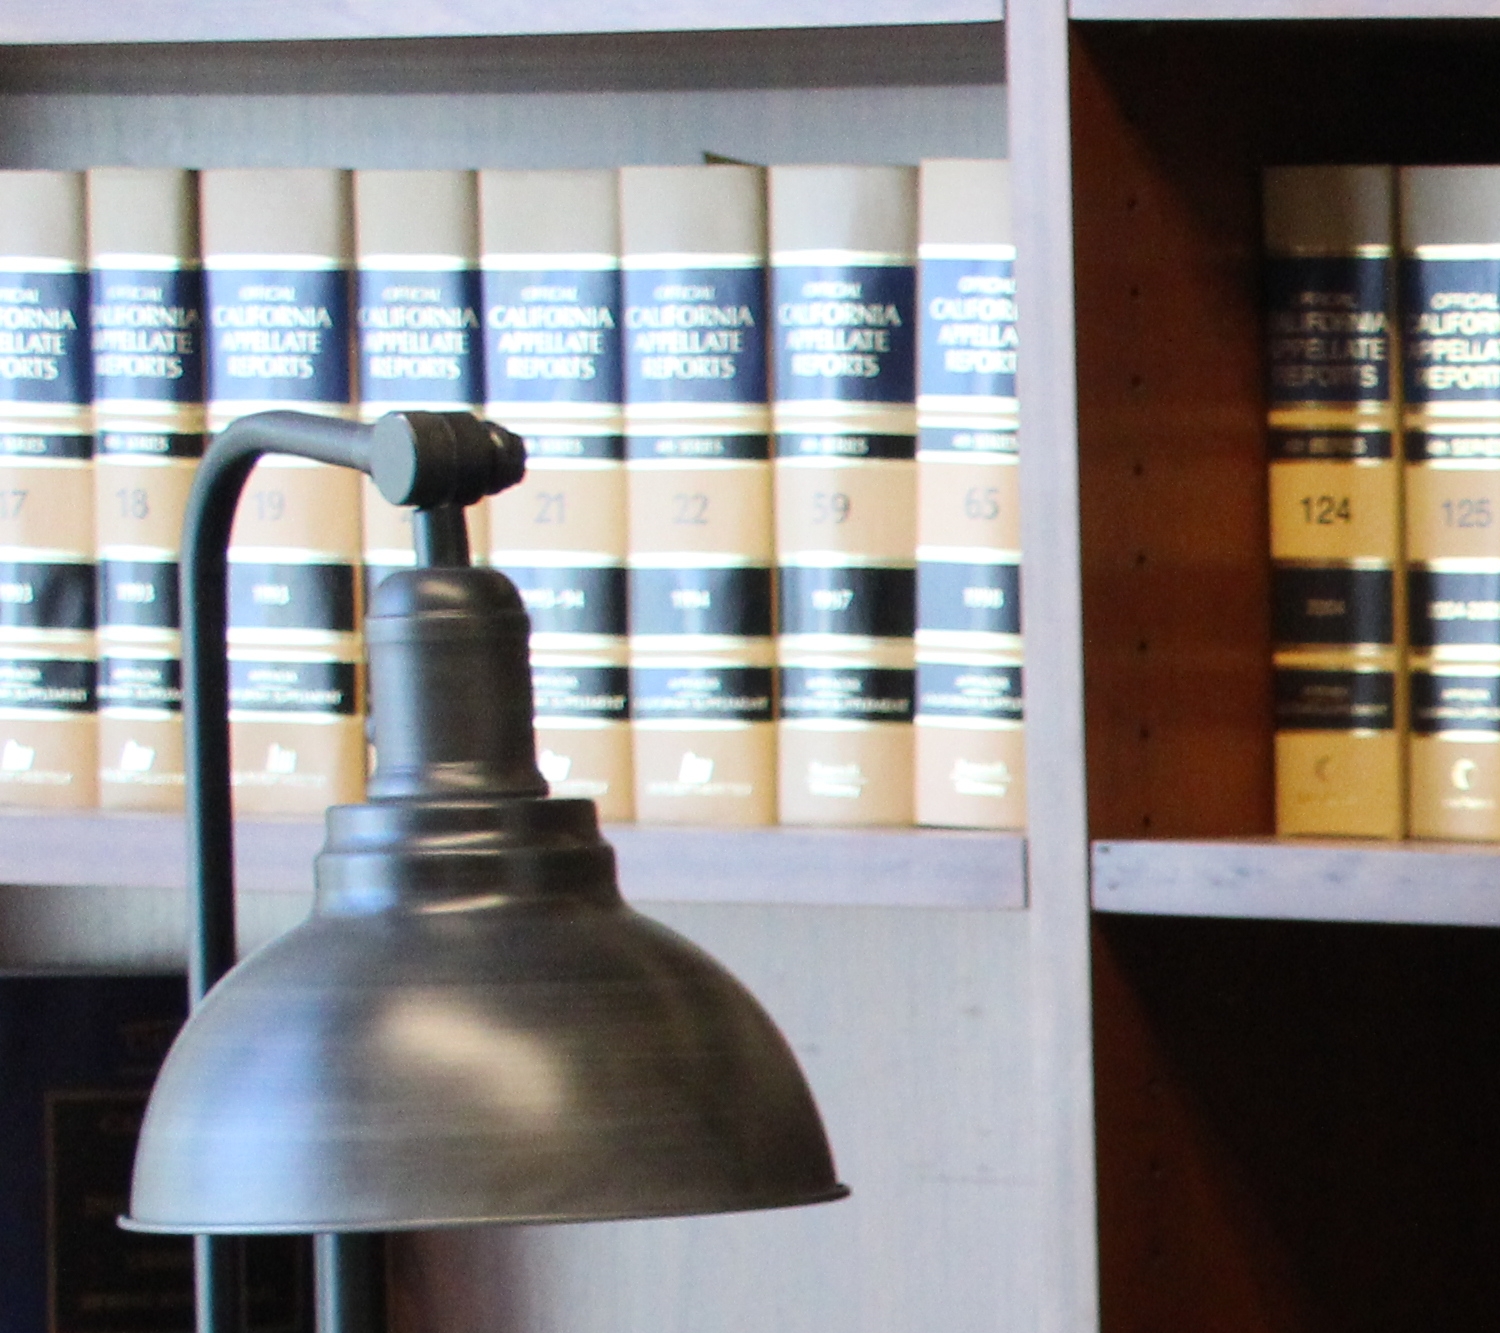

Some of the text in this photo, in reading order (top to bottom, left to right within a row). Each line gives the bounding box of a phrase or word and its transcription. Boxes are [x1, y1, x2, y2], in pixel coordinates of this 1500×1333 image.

[116, 489, 148, 520] 18
[253, 490, 285, 522] 19
[535, 492, 566, 524] 21
[673, 492, 708, 525] 22
[812, 492, 849, 524] 59
[965, 487, 1000, 521] 65
[1301, 497, 1352, 527] 124
[1442, 499, 1492, 529] 125
